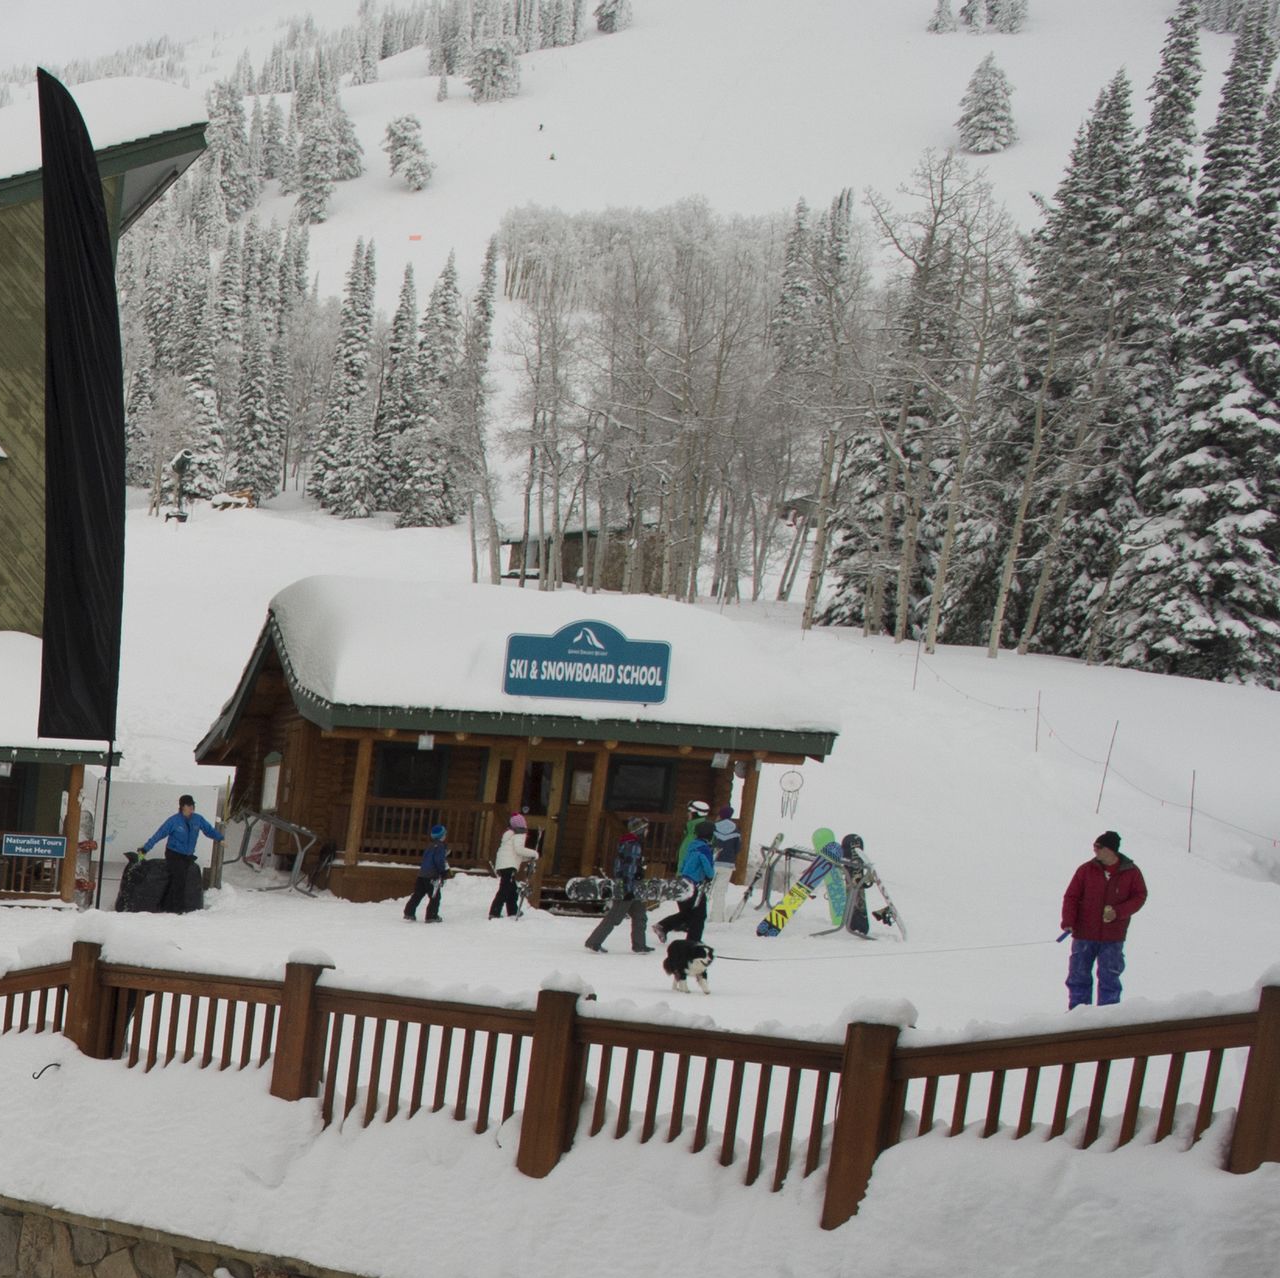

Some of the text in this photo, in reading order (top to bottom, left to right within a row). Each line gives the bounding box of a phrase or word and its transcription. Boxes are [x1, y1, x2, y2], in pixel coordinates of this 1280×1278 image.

[509, 659, 663, 687] SKI & SNOWBOARD SCHOOL
[6, 837, 40, 845] Naturalist
